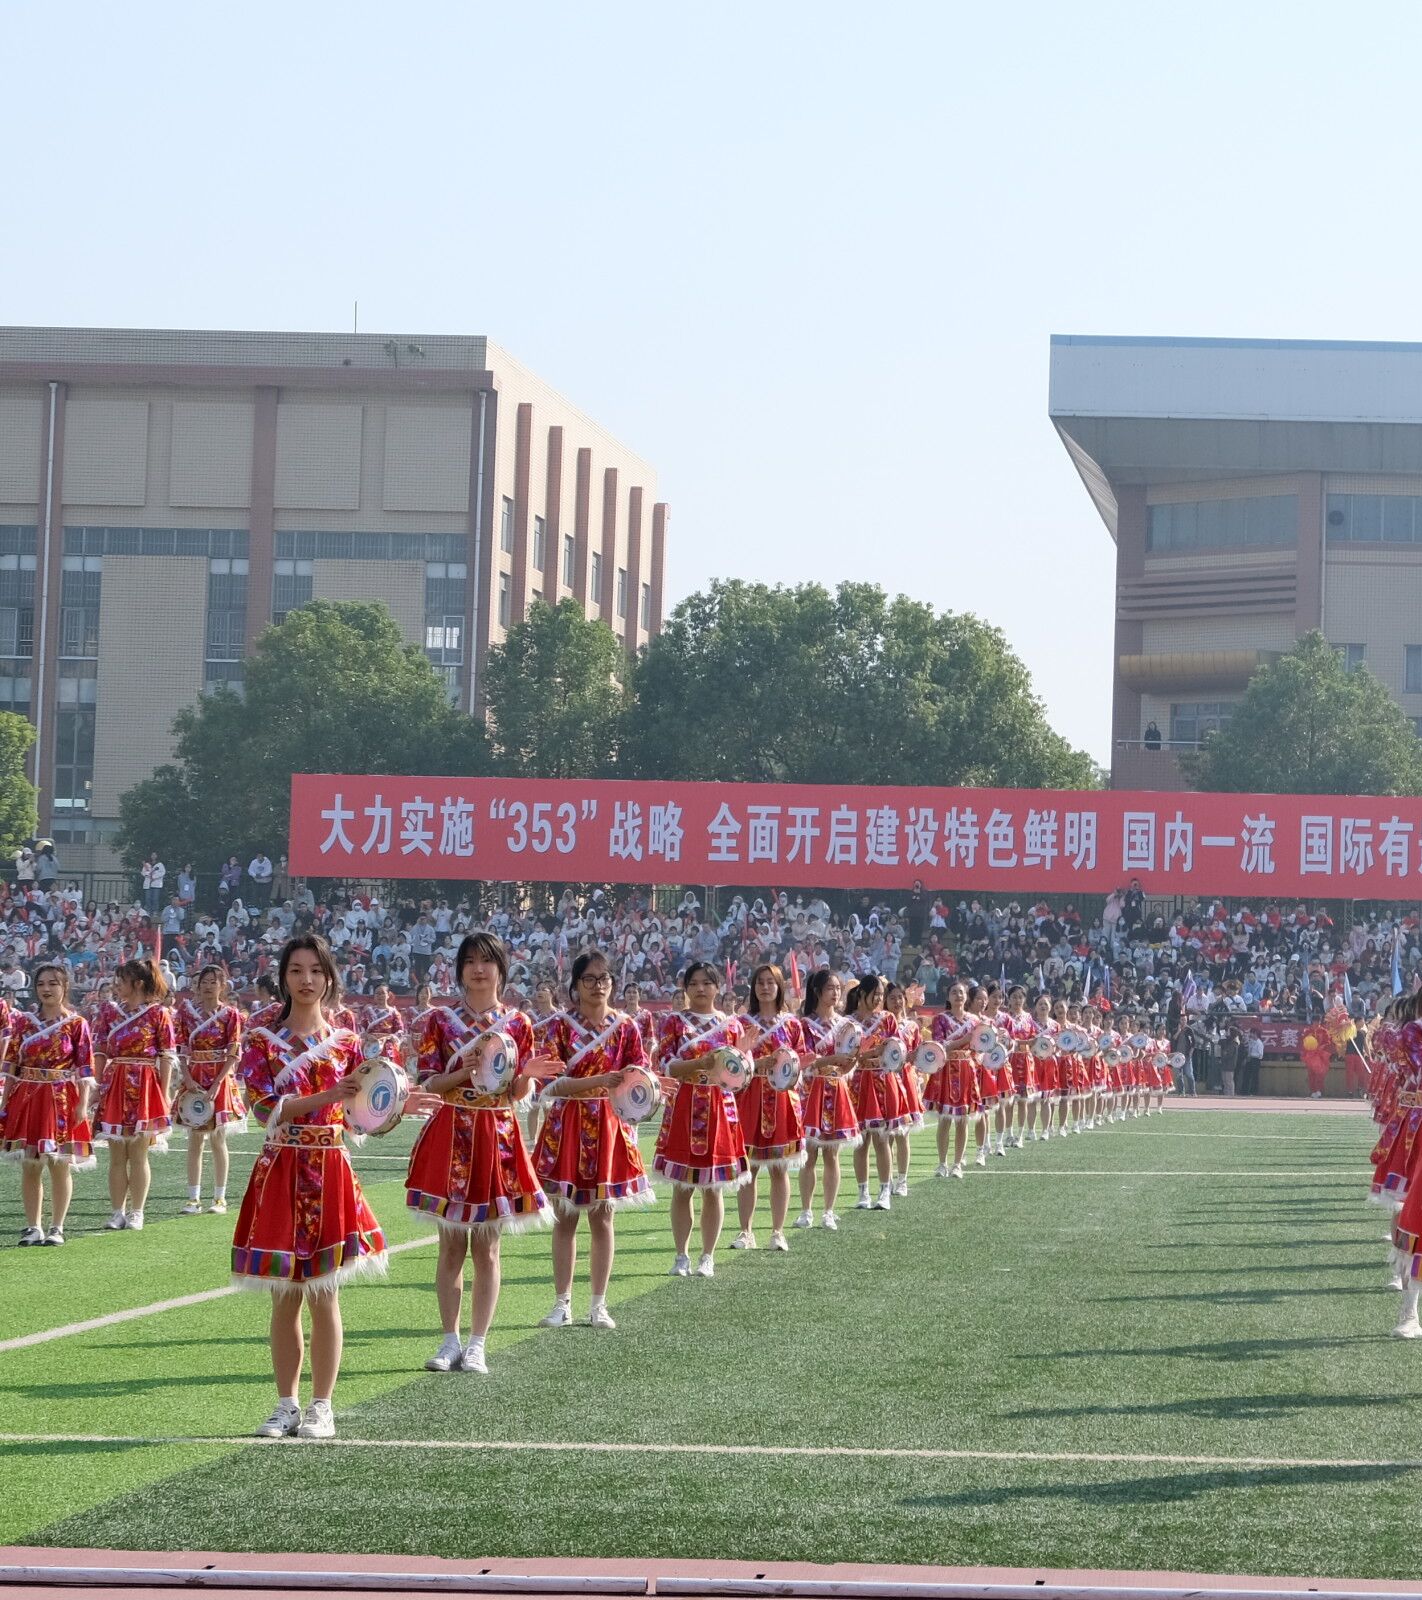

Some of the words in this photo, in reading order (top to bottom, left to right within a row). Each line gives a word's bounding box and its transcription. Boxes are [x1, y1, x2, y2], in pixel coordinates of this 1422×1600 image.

[706, 802, 1097, 870] 全面开启建设特色鲜明
[1122, 811, 1277, 874] 国内一流
